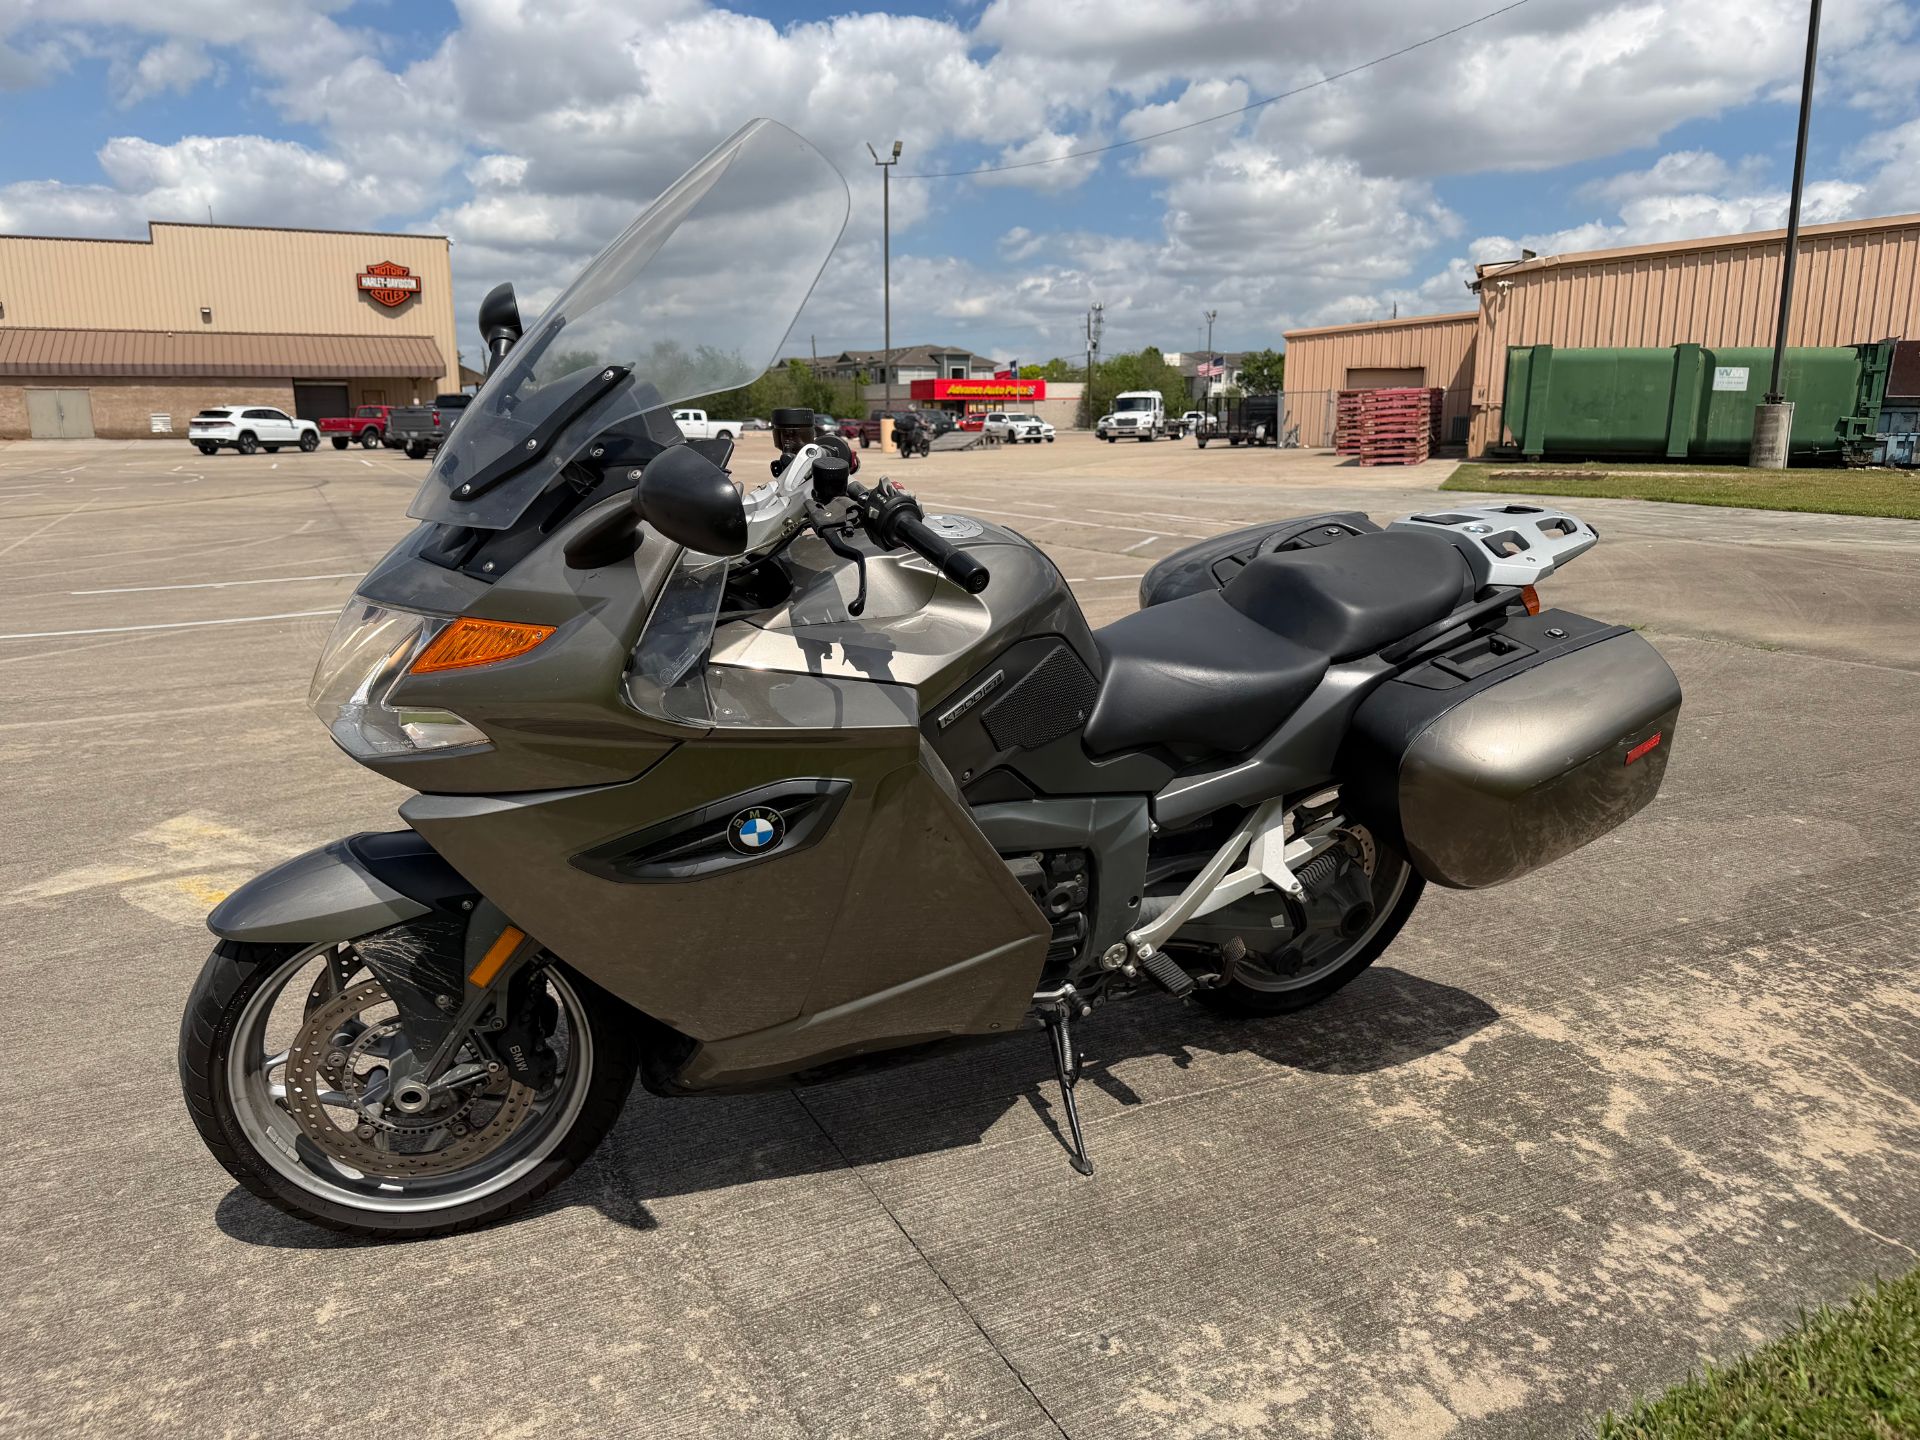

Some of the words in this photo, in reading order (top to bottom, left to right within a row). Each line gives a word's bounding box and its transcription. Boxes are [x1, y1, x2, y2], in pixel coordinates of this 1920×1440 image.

[947, 384, 983, 395] Advance
[984, 385, 1004, 395] Auto
[1005, 385, 1029, 395] Parts
[733, 809, 778, 828] BMW
[510, 1045, 528, 1071] BMW
